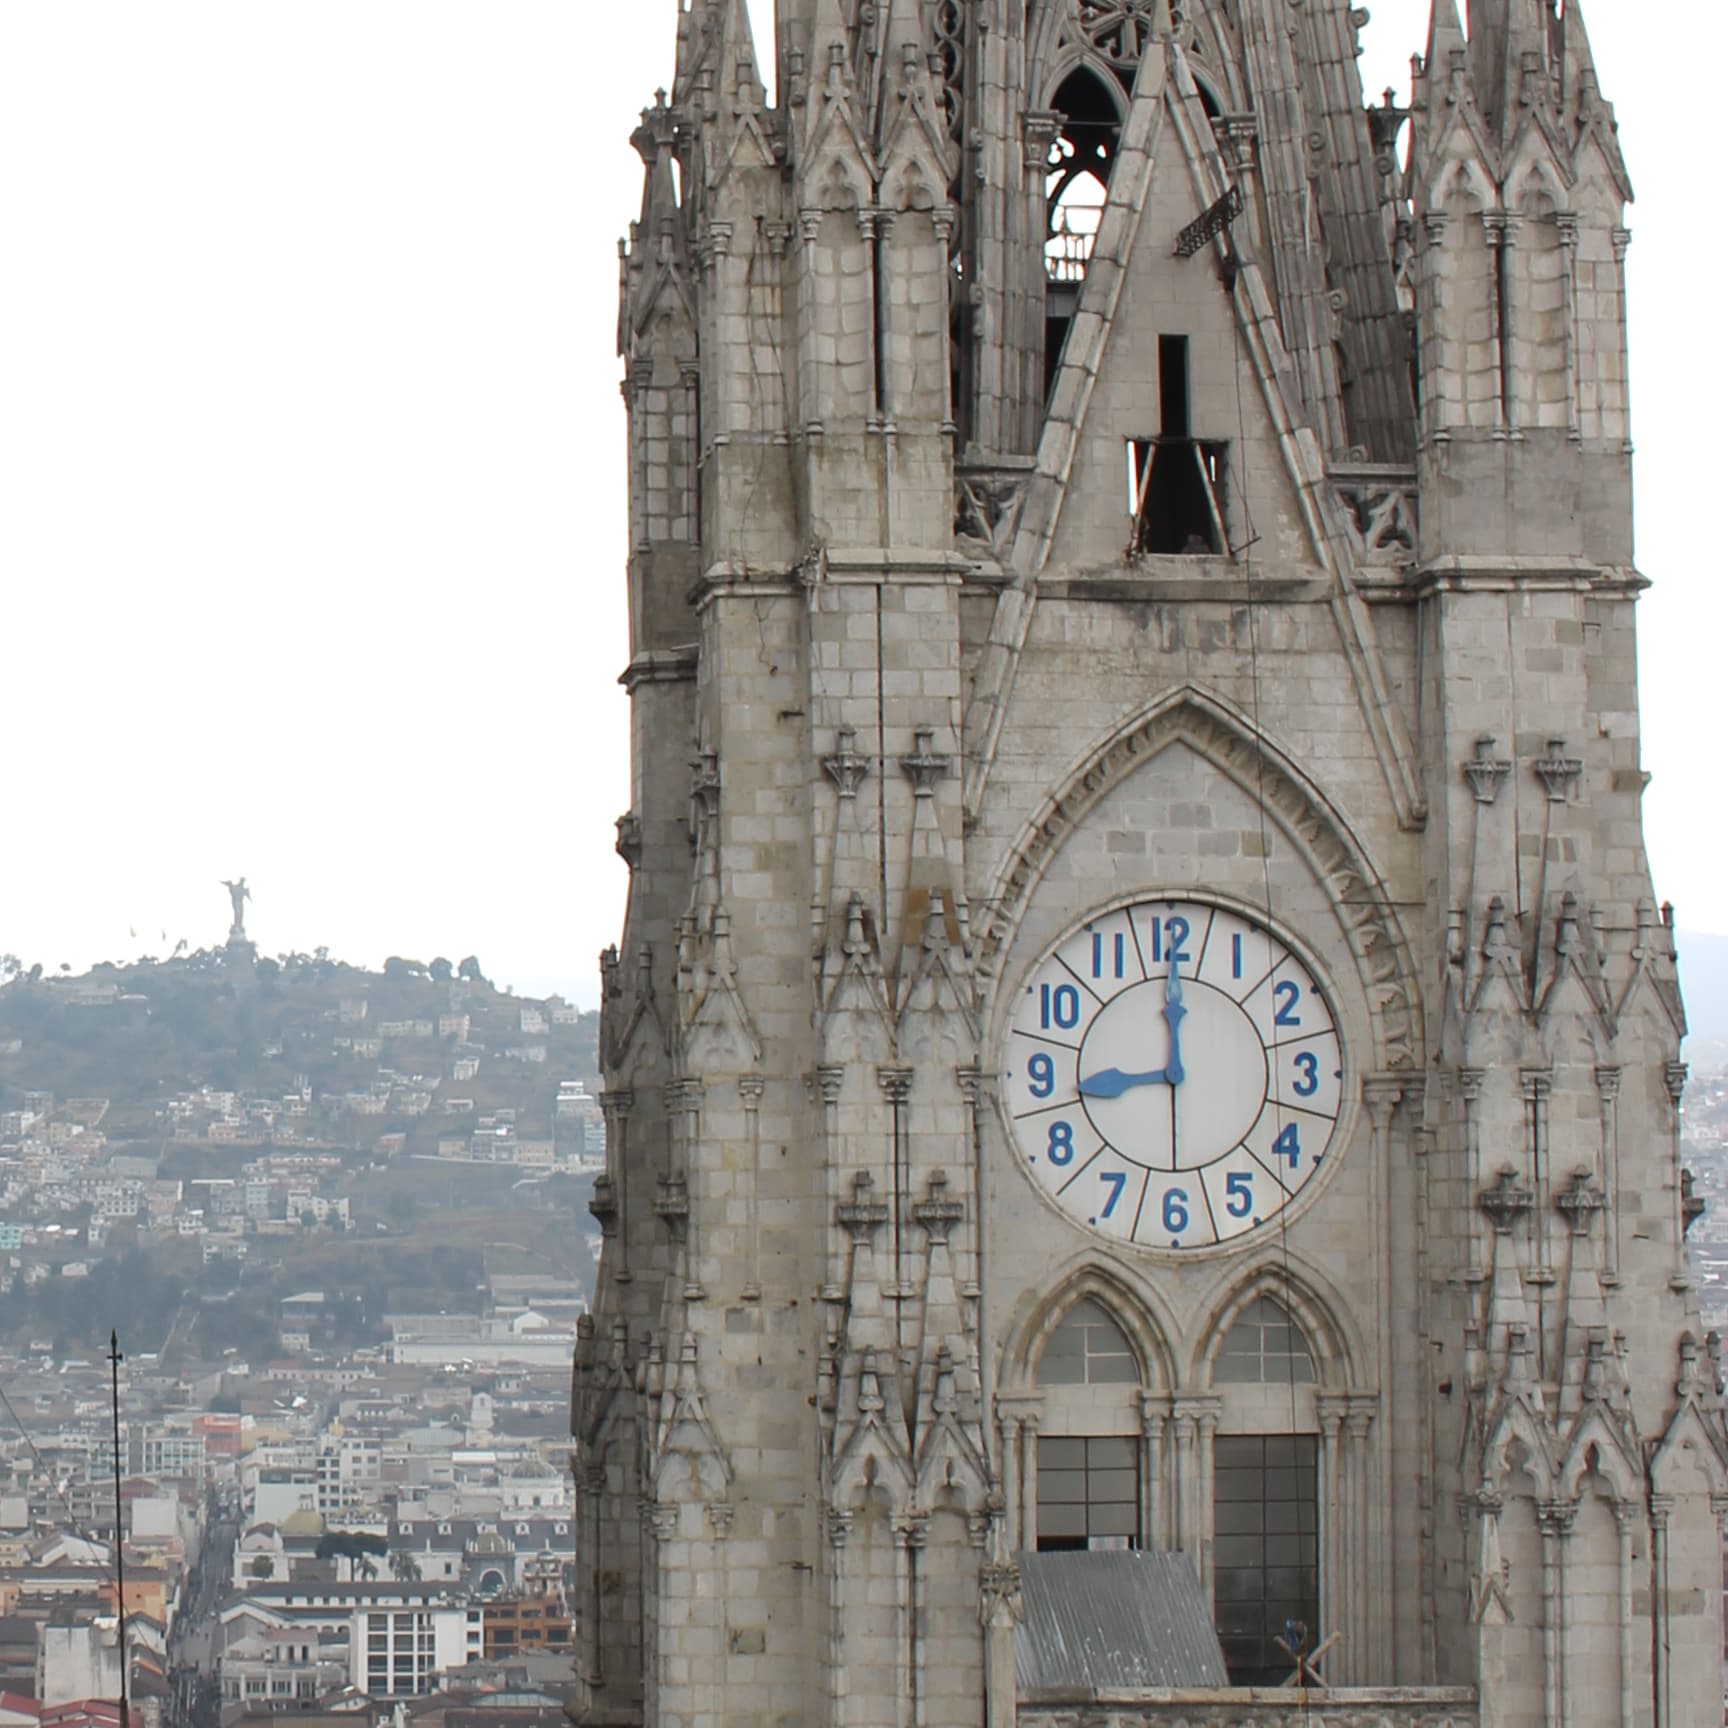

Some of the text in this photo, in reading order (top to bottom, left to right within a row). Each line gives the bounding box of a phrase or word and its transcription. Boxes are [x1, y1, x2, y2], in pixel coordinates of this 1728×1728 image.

[1093, 933, 1123, 978] 11
[1152, 916, 1190, 962] 12
[1233, 934, 1241, 979] 1
[1041, 984, 1079, 1029] 10
[1274, 981, 1300, 1026] 2
[1028, 1053, 1054, 1098] 9
[1293, 1051, 1318, 1096] 3
[1048, 1121, 1073, 1166] 8
[1272, 1123, 1300, 1168] 4
[1100, 1172, 1126, 1218] 7
[1162, 1188, 1188, 1233] 6
[1226, 1172, 1253, 1217] 5
